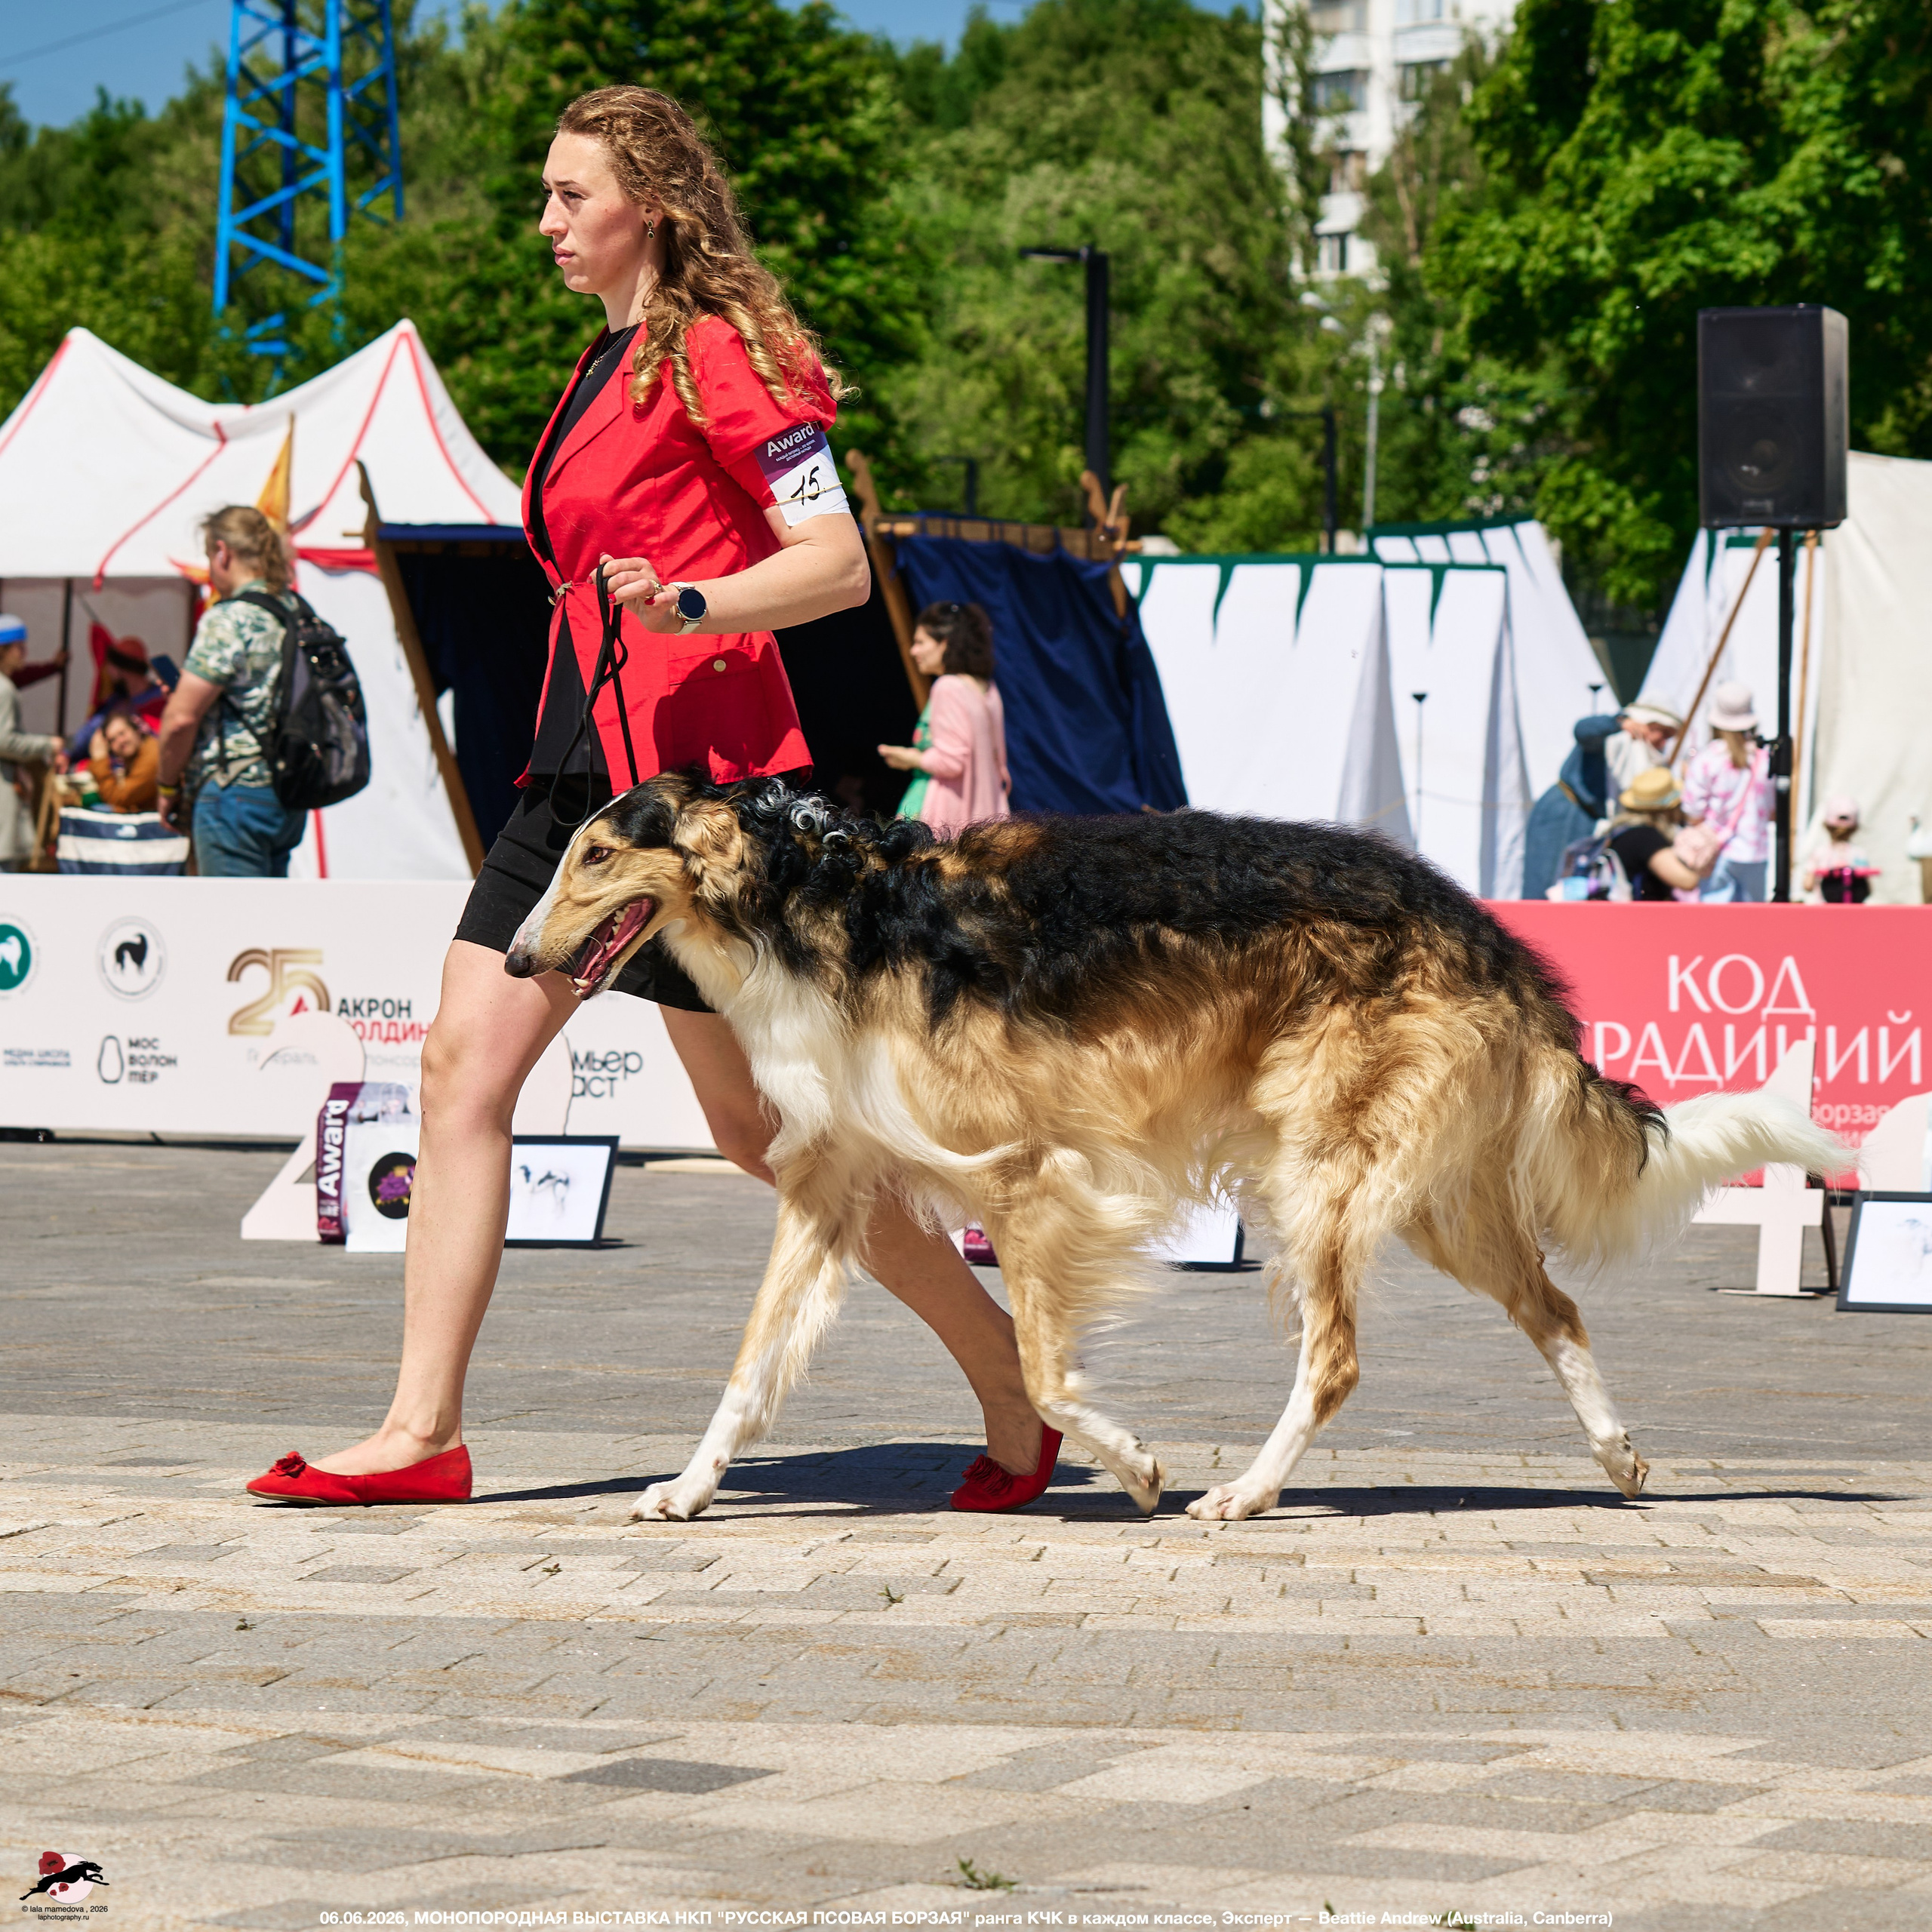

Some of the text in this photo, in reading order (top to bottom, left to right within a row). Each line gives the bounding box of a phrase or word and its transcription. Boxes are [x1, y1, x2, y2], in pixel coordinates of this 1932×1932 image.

[767, 422, 815, 457] Award
[338, 998, 412, 1019] АКРОН
[1668, 953, 1816, 1022] КОД
[318, 1100, 349, 1197] Award
